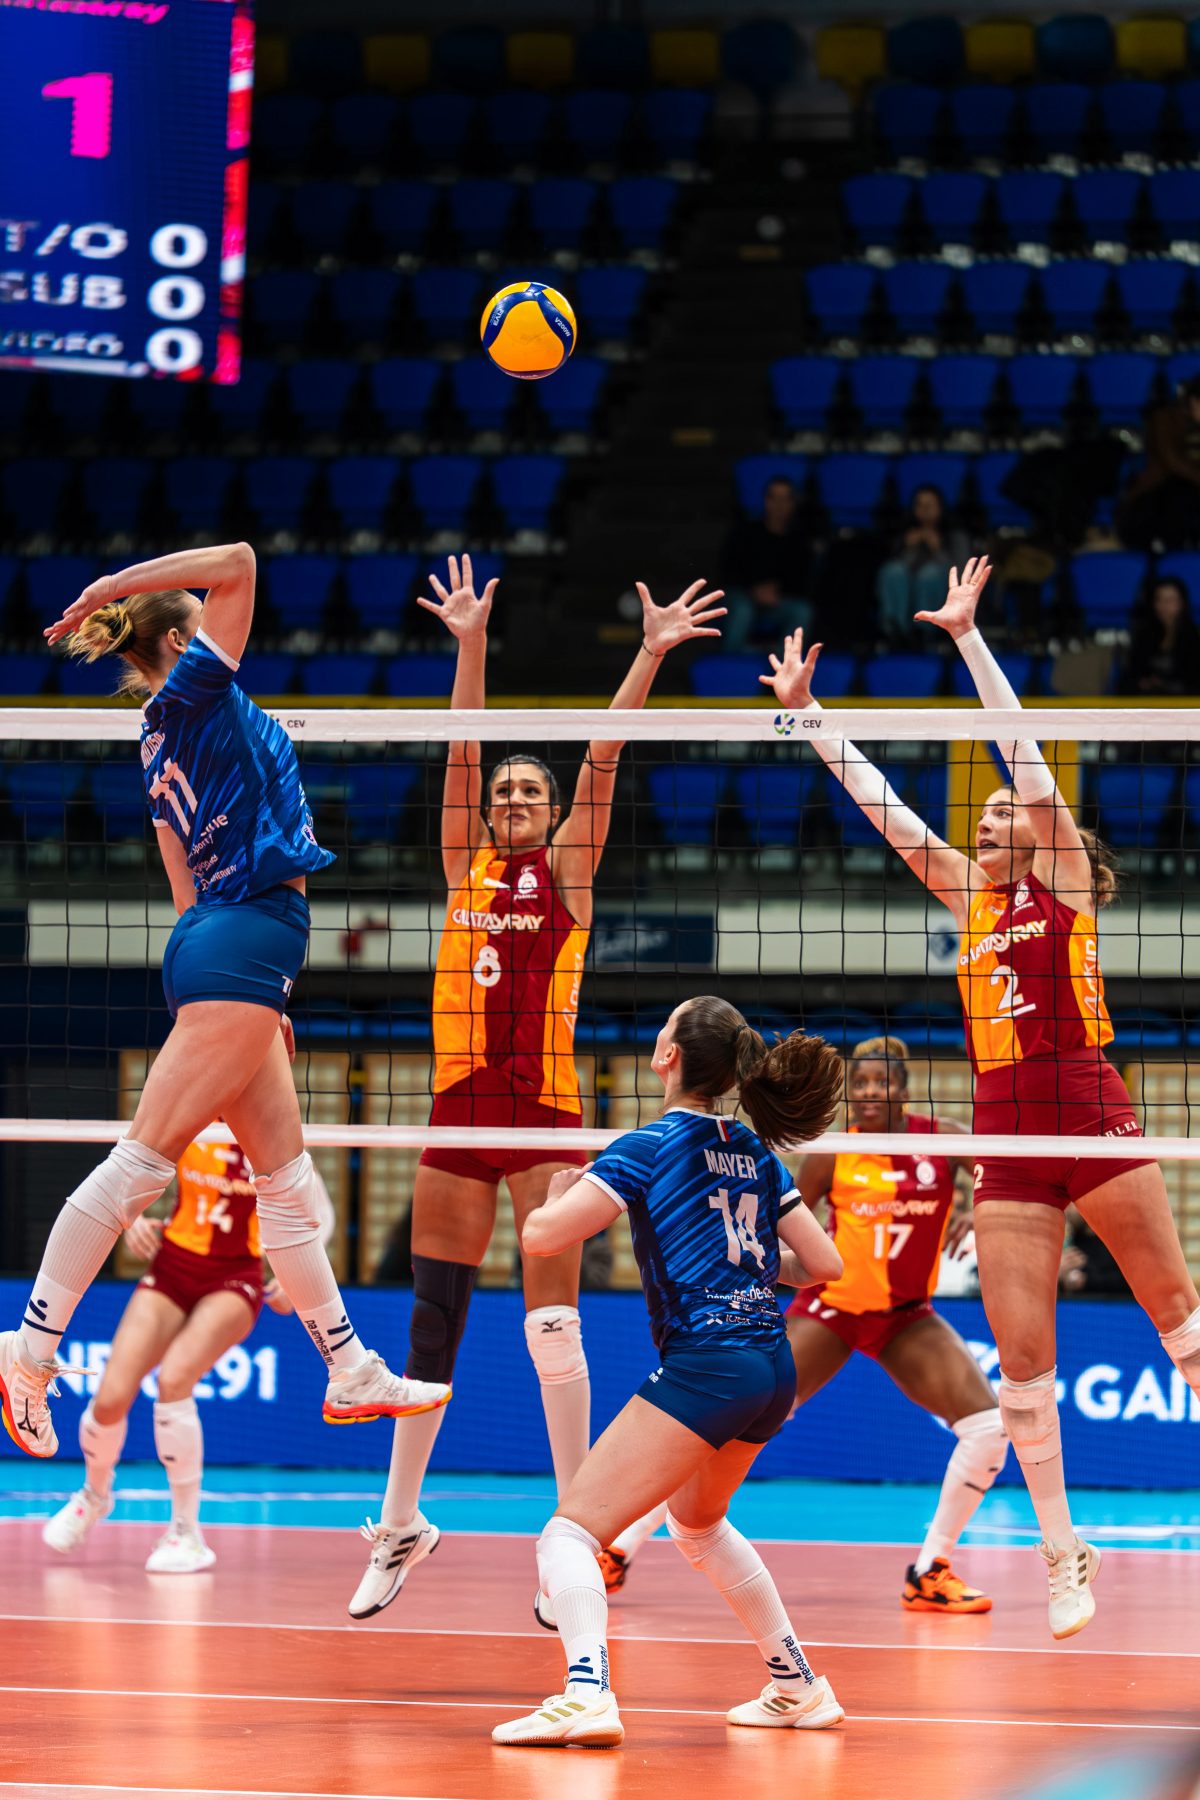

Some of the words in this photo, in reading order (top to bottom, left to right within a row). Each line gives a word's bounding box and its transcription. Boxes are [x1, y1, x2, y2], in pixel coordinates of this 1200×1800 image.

[41, 72, 113, 159] 1
[149, 222, 208, 269] 0
[147, 274, 206, 321] 0
[145, 327, 203, 373] 0
[287, 719, 306, 729] CEV
[802, 719, 822, 729] CEV
[473, 944, 502, 988] 8
[990, 964, 1025, 1012] 2
[703, 1148, 758, 1181] MAYER
[973, 1163, 984, 1190] 2
[195, 1194, 233, 1234] 14
[708, 1187, 766, 1271] 14
[873, 1223, 914, 1260] 17
